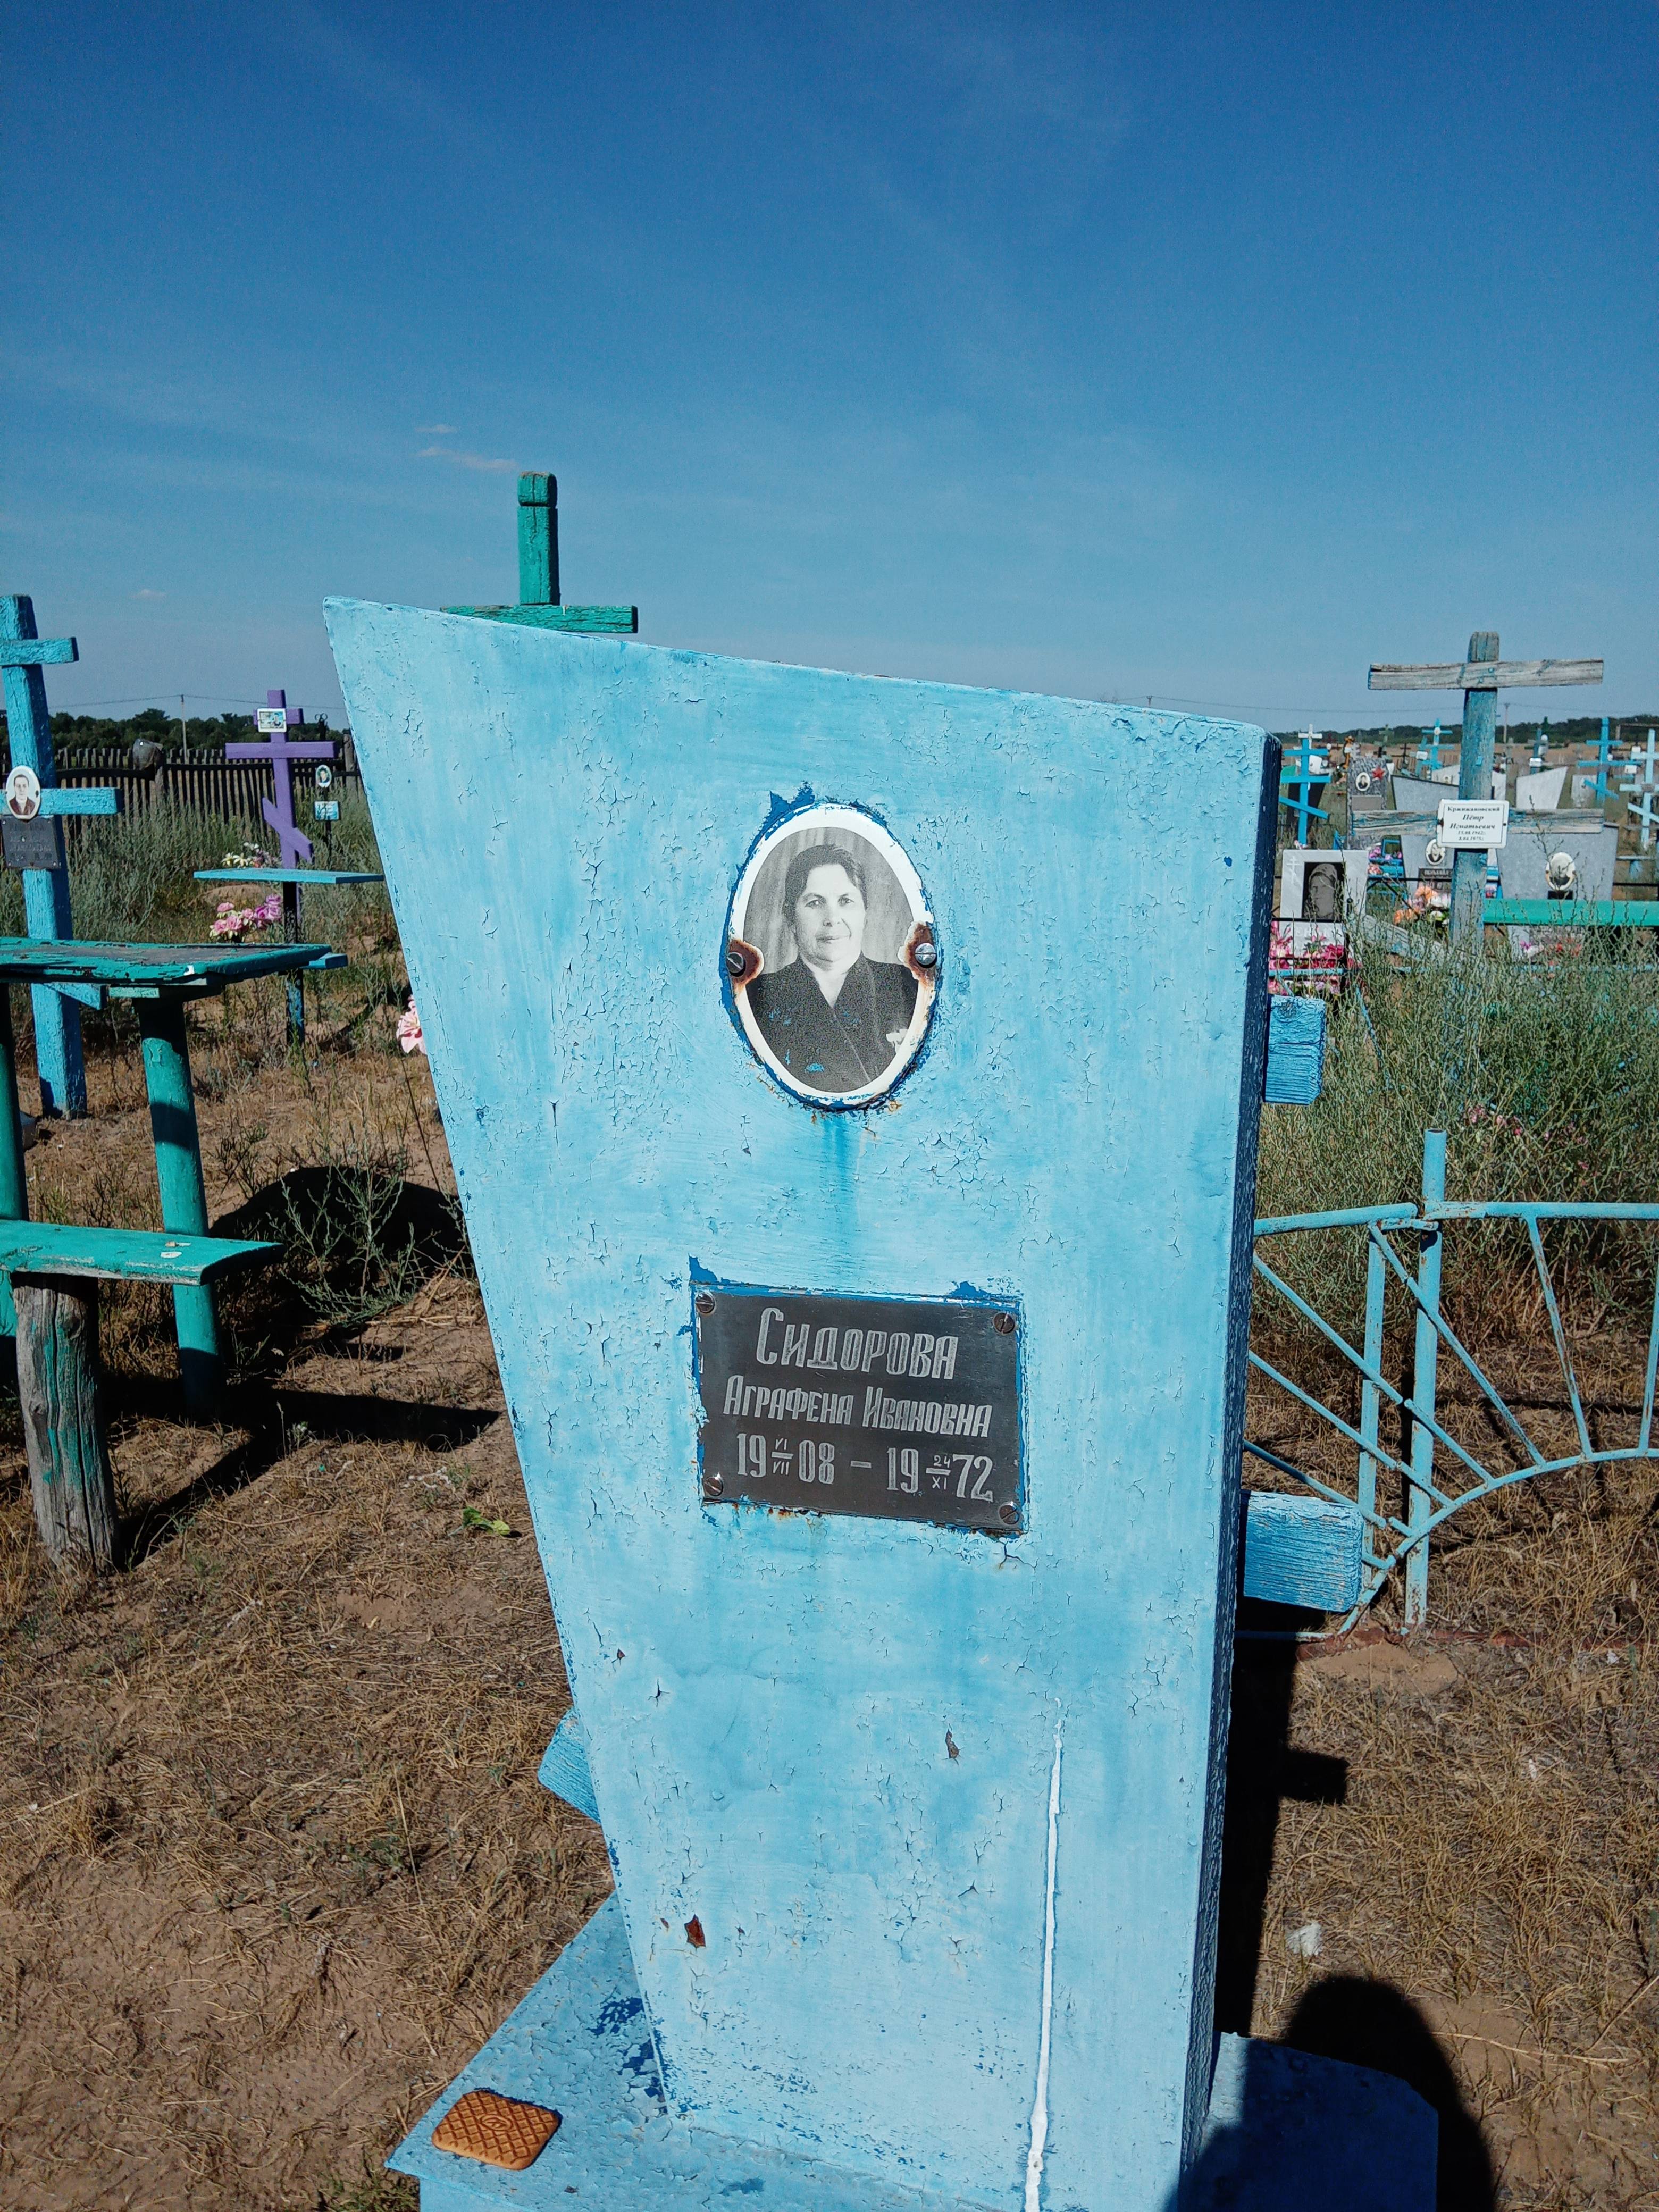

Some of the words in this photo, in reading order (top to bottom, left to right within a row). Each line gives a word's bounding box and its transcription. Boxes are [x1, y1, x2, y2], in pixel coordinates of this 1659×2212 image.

[736, 1432, 767, 1478] 19
[799, 1439, 835, 1485] 08
[886, 1447, 919, 1493] 19
[952, 1453, 994, 1503] 72
